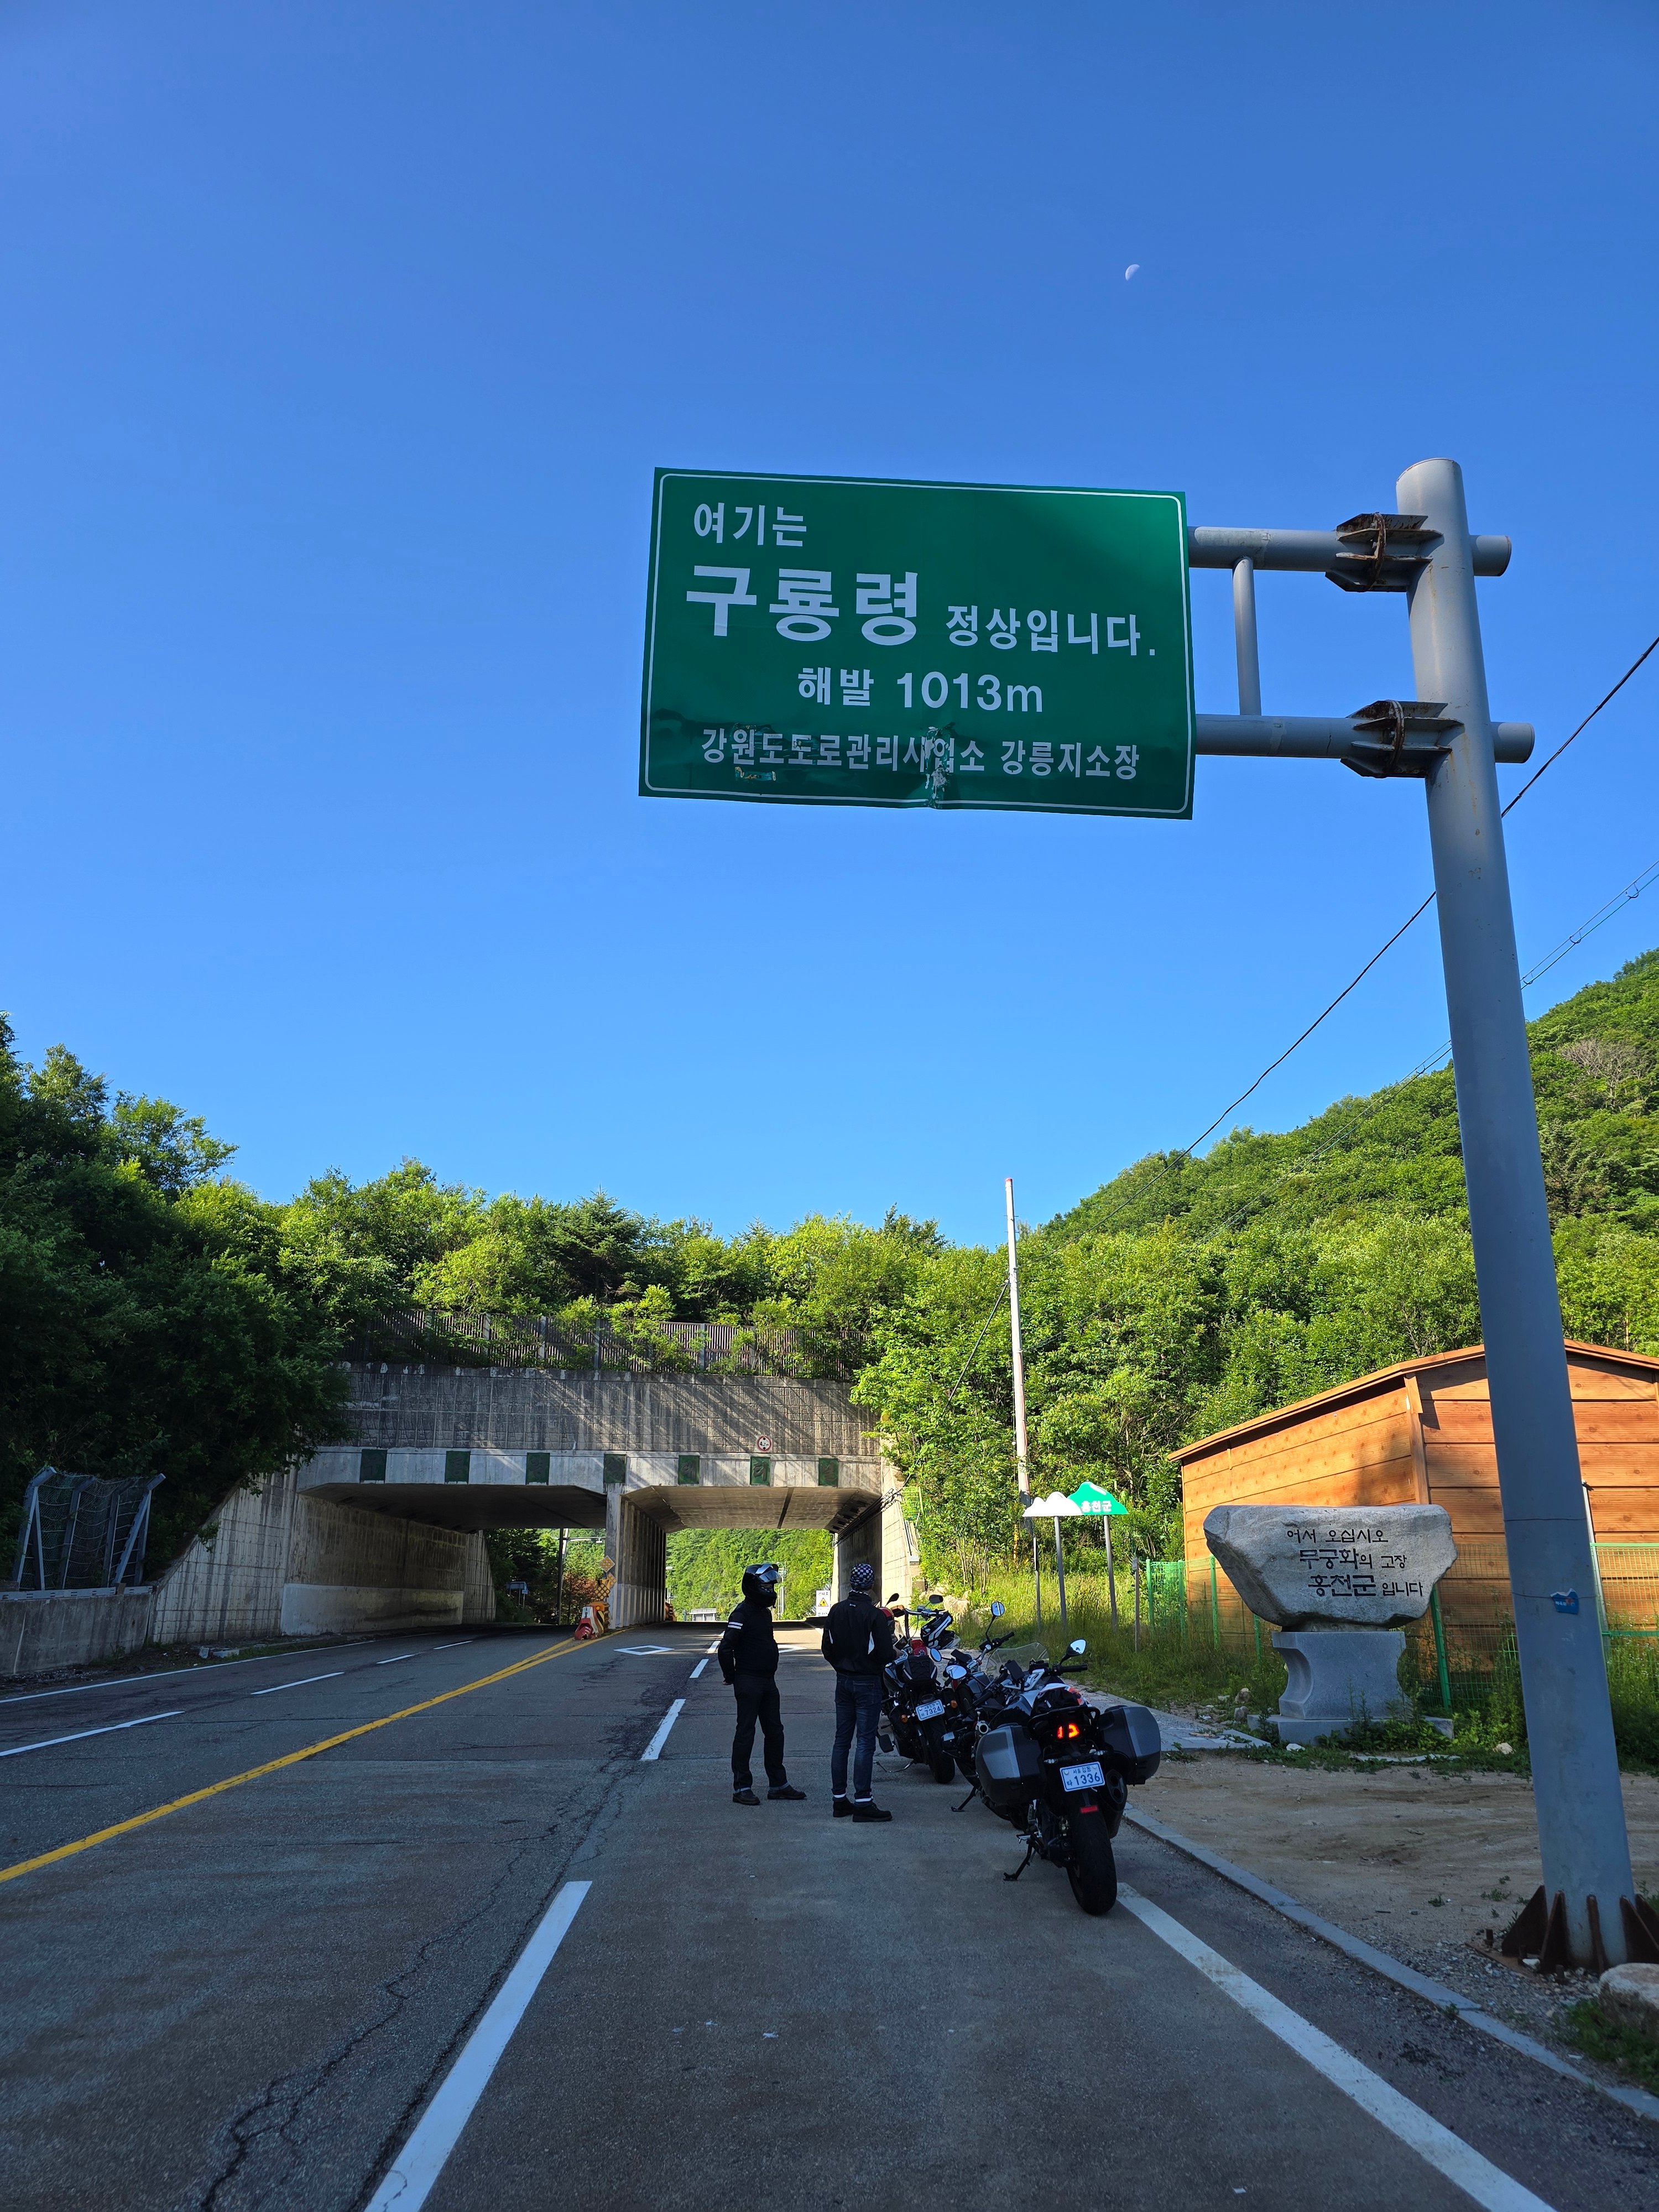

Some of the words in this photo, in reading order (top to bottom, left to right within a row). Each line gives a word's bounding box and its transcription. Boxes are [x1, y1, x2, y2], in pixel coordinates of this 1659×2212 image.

[694, 502, 807, 547] 여기는
[686, 565, 919, 646] 구룡령
[946, 605, 1156, 656] 정상입니다.
[797, 666, 874, 707] 해발
[897, 671, 1044, 713] 1013m
[1000, 739, 1140, 780] 강릉지소장
[1081, 1500, 1112, 1512] 홍천군
[1287, 1528, 1316, 1543] 어서
[1326, 1528, 1389, 1543] 오십시오
[1300, 1548, 1373, 1570] 무궁화의
[1380, 1554, 1407, 1569] 고장
[1308, 1574, 1376, 1598] 홍천군
[1382, 1582, 1423, 1597] 입니다
